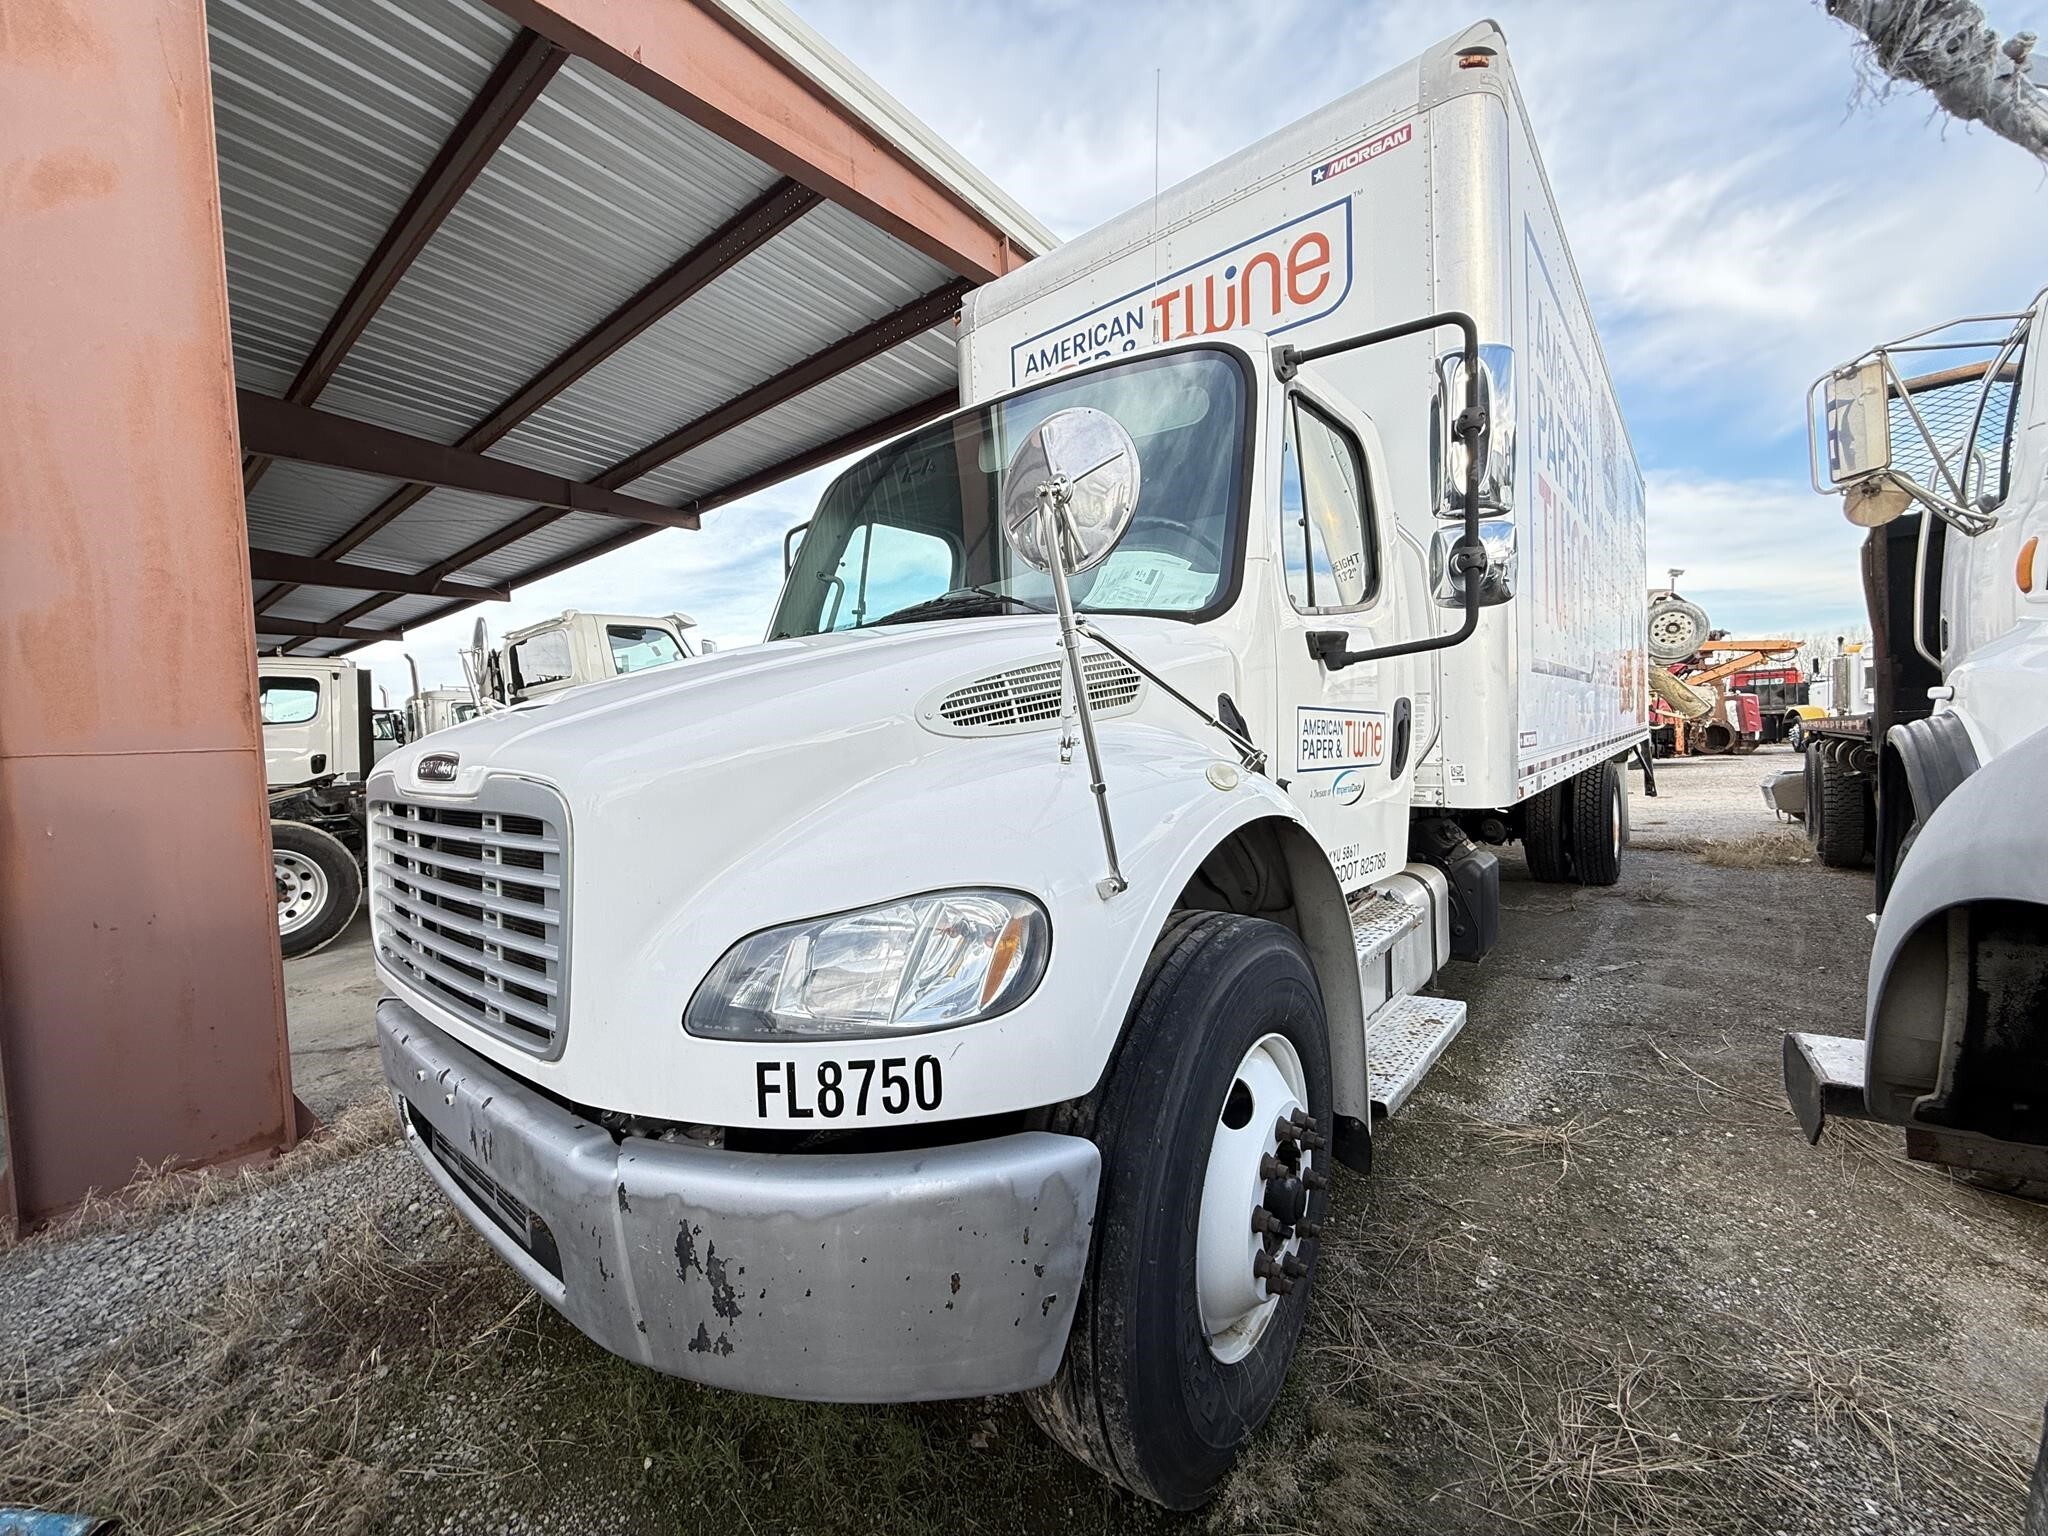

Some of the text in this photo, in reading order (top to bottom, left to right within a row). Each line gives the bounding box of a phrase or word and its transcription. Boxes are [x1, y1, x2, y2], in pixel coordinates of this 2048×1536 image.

[1328, 127, 1410, 177] MORGAN
[1024, 305, 1144, 377] AMERICAN
[1536, 297, 1590, 458] AMERICAN
[1536, 373, 1591, 527] PAPER &
[1302, 718, 1343, 736] AMERICAN
[1302, 738, 1343, 760] PAPER &
[1345, 720, 1382, 758] Twine
[756, 1054, 942, 1119] FL8750
